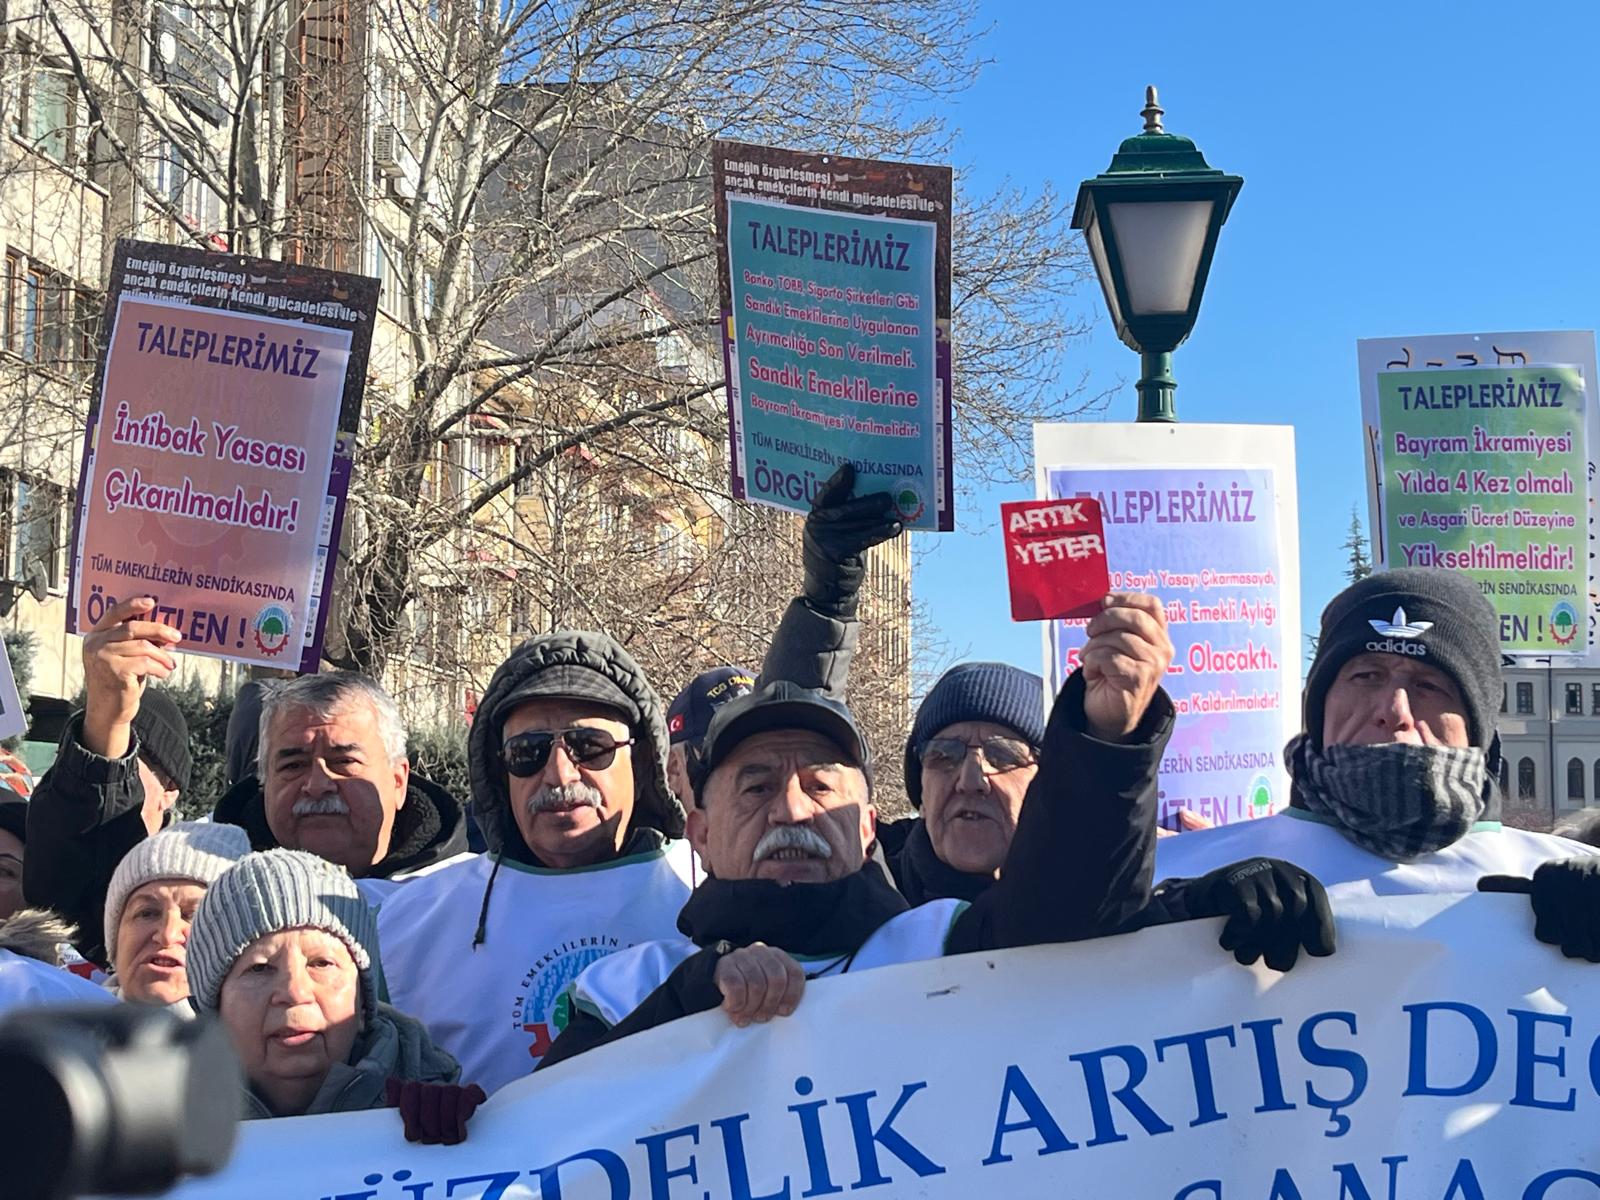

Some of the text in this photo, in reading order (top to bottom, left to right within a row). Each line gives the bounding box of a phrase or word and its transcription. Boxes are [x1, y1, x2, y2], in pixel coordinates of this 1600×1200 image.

[724, 159, 830, 186] Emeğin özgürleşmesi
[725, 174, 755, 189] ancak
[757, 178, 818, 199] emekçilerin
[820, 187, 850, 203] kendi
[852, 192, 918, 211] mücadelesi
[748, 220, 911, 272] TALEPLERİMİZ
[126, 257, 246, 286] Emeğin özgürleşmesi
[123, 273, 157, 289] ancak
[160, 278, 228, 297] emekçilerin
[231, 289, 264, 306] kendi
[267, 295, 340, 319] mücadelesi
[807, 282, 843, 300] Sigorta
[846, 288, 893, 306] Şirketleri
[895, 294, 919, 309] Gibi
[745, 295, 781, 315] Sandık
[784, 303, 849, 328] Emeklilerine
[853, 316, 919, 337] Uygulanan
[138, 322, 321, 379] TALEPLERİMİZ
[746, 324, 917, 368] Ayrımcılığa Son Verilmeli.
[750, 358, 919, 407] Sandık Emeklilerine
[1398, 376, 1564, 411] TALEPLERİMİZ
[751, 394, 920, 438] Bayram İkramiyesi Verilmelidir!
[113, 402, 306, 472] İntibak Yasası
[752, 432, 773, 449] TÜM
[774, 437, 835, 466] EMEKLİLERİN
[1395, 425, 1572, 460] Bayram İkramiyesi
[754, 458, 825, 501] ÖRGÜ
[1398, 470, 1573, 494] Yılda 4 Kez olmalı
[105, 469, 299, 532] Çıkarılmalıdır!
[1009, 502, 1089, 533] ARTIK
[1075, 480, 1257, 525] ALEPLERİMİZ
[1399, 506, 1575, 531] ve Asgari Ücret Düzeyine
[1012, 533, 1105, 566] YETER
[1401, 542, 1574, 571] Yükseltilmelidir!
[91, 554, 295, 603] TÜM EMEKLİLERİN SENDİKASINDA
[1126, 570, 1157, 592] Sayılı
[1160, 572, 1199, 591] Yasayı
[1201, 569, 1276, 590] Çıkarmasaydı,
[1499, 579, 1578, 597] SENDİKASINDA
[1191, 601, 1236, 622] Emekli
[1241, 601, 1277, 626] Aylığı
[236, 617, 248, 648] !
[1366, 639, 1427, 656] adidas
[1189, 641, 1278, 673] Olacaktı.
[1192, 693, 1280, 712] Kaldırılmalıdır!
[1196, 751, 1275, 773] SENDİKASINDA
[521, 934, 619, 988] EMEKLİLERİN
[982, 1009, 1370, 1167] ARTIŞ
[1402, 1000, 1600, 1112] DE
